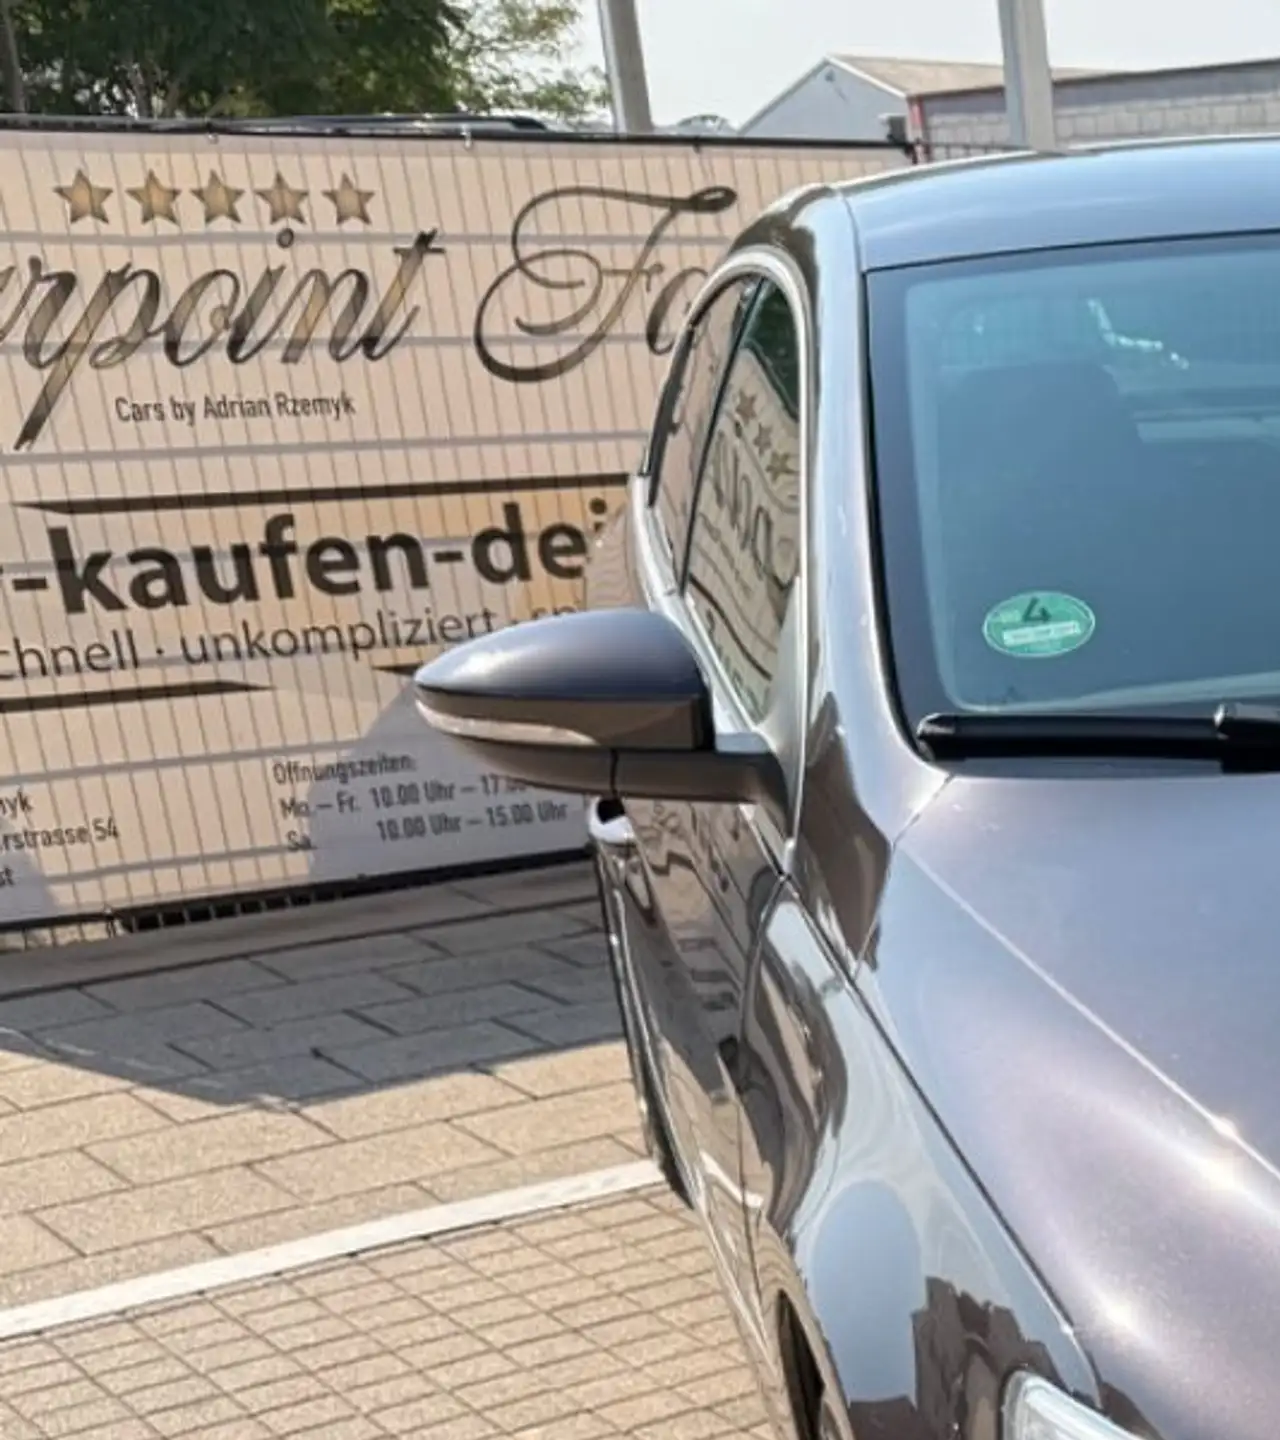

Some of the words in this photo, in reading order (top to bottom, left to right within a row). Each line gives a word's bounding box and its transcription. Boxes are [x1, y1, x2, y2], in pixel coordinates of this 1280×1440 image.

[0, 227, 447, 452] rpoint
[115, 397, 165, 422] Cars
[169, 395, 196, 427] by
[204, 394, 272, 419] Adrian
[274, 391, 356, 421] Rzemyk
[0, 497, 609, 614] -kaufen-de
[180, 606, 498, 664] unkompliziert
[424, 778, 455, 804] Uhr
[536, 799, 568, 823] Uhr
[0, 826, 90, 852] rstrasse
